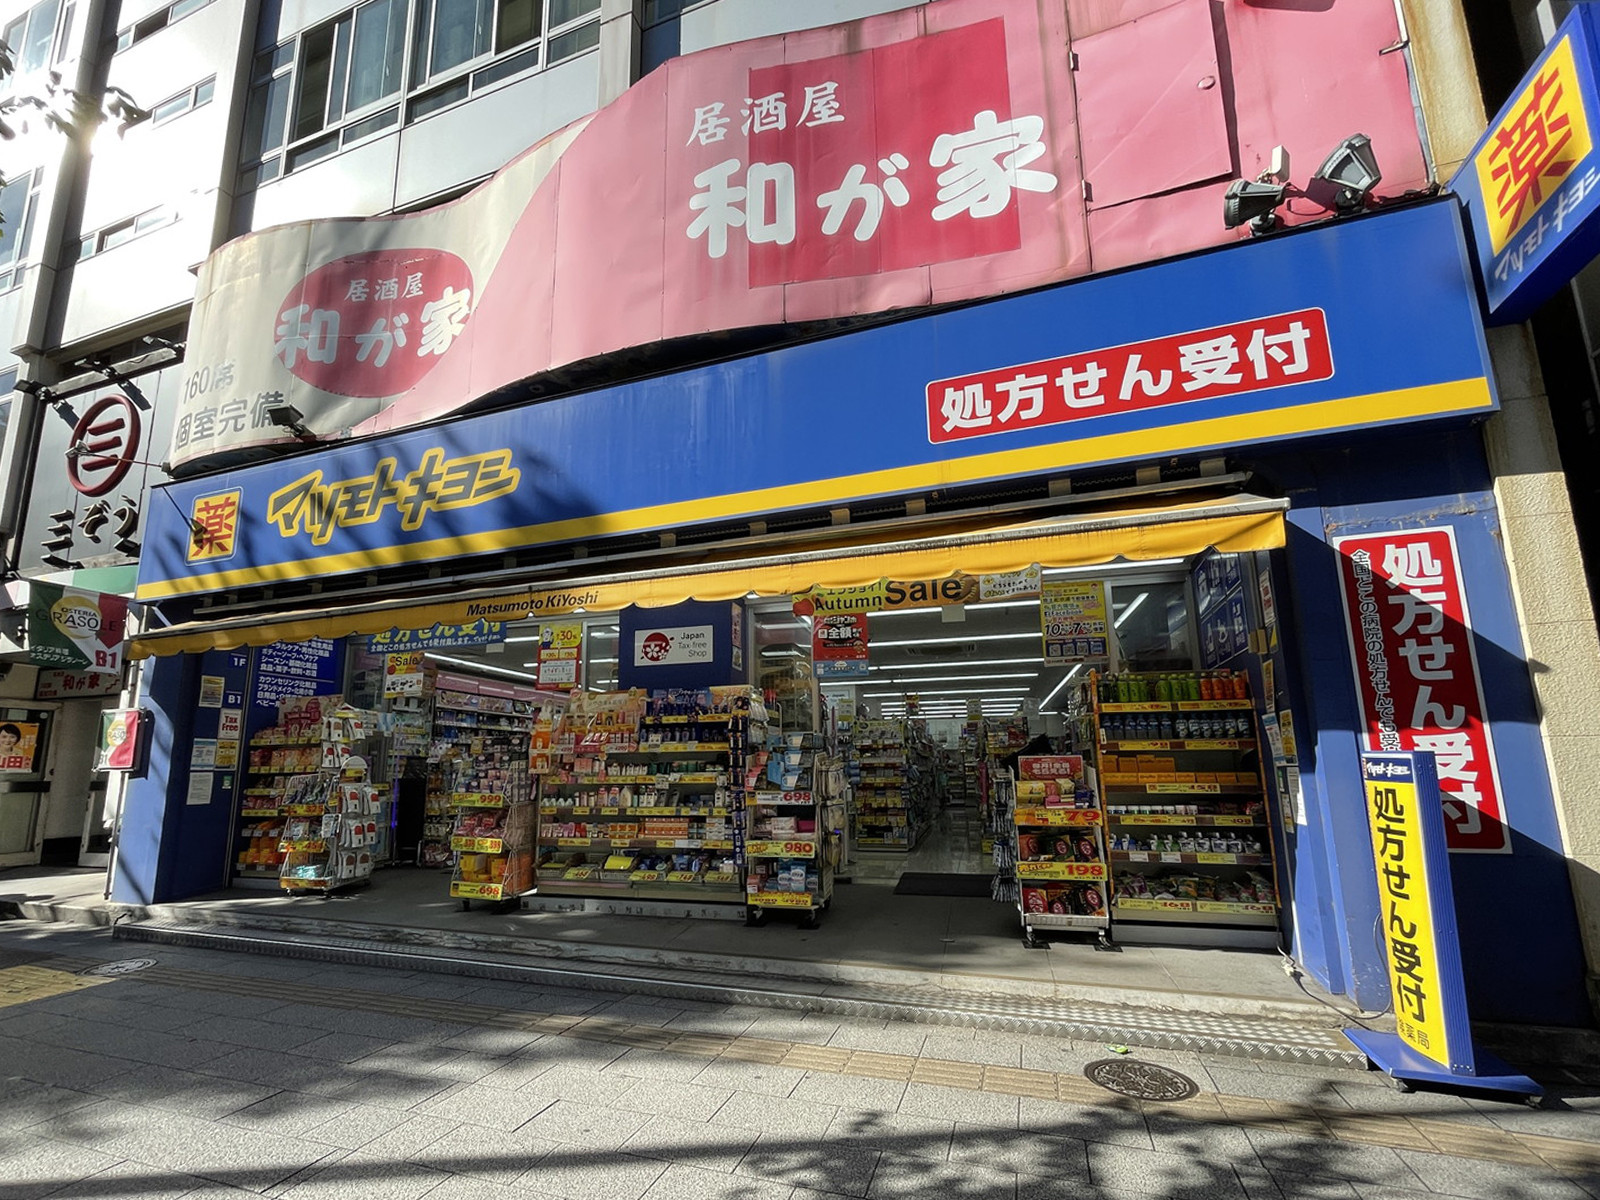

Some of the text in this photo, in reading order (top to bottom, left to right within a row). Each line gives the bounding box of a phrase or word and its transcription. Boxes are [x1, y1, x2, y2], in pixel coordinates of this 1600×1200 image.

[686, 81, 845, 147] 居酒屋
[1489, 67, 1577, 241] 薬
[686, 110, 1057, 259] 和が家
[1495, 166, 1600, 282] マツモトキヨシ
[344, 271, 424, 302] 居酒屋
[274, 287, 471, 369] 和が家
[940, 321, 1312, 433] 処方せん受付
[268, 448, 520, 545] マツモトキヨシ
[191, 496, 237, 557] 薬
[815, 595, 882, 611] Autumn
[885, 579, 963, 603] Sale
[467, 599, 543, 617] Matsumoto
[35, 609, 118, 632] GRASOLE
[680, 632, 705, 642] Japan
[95, 650, 117, 669] B1
[234, 658, 247, 667] 1F
[395, 655, 418, 667] Sale
[688, 649, 707, 658] Shop
[228, 695, 241, 704] B1
[221, 723, 238, 732] Free
[224, 715, 238, 723] Tax
[479, 794, 502, 803] 999
[783, 792, 812, 802] 698
[1064, 810, 1101, 822] 79
[784, 842, 814, 853] 980
[1066, 864, 1104, 876] 198
[479, 885, 501, 896] 698
[1373, 786, 1428, 1024] 処方せん受付
